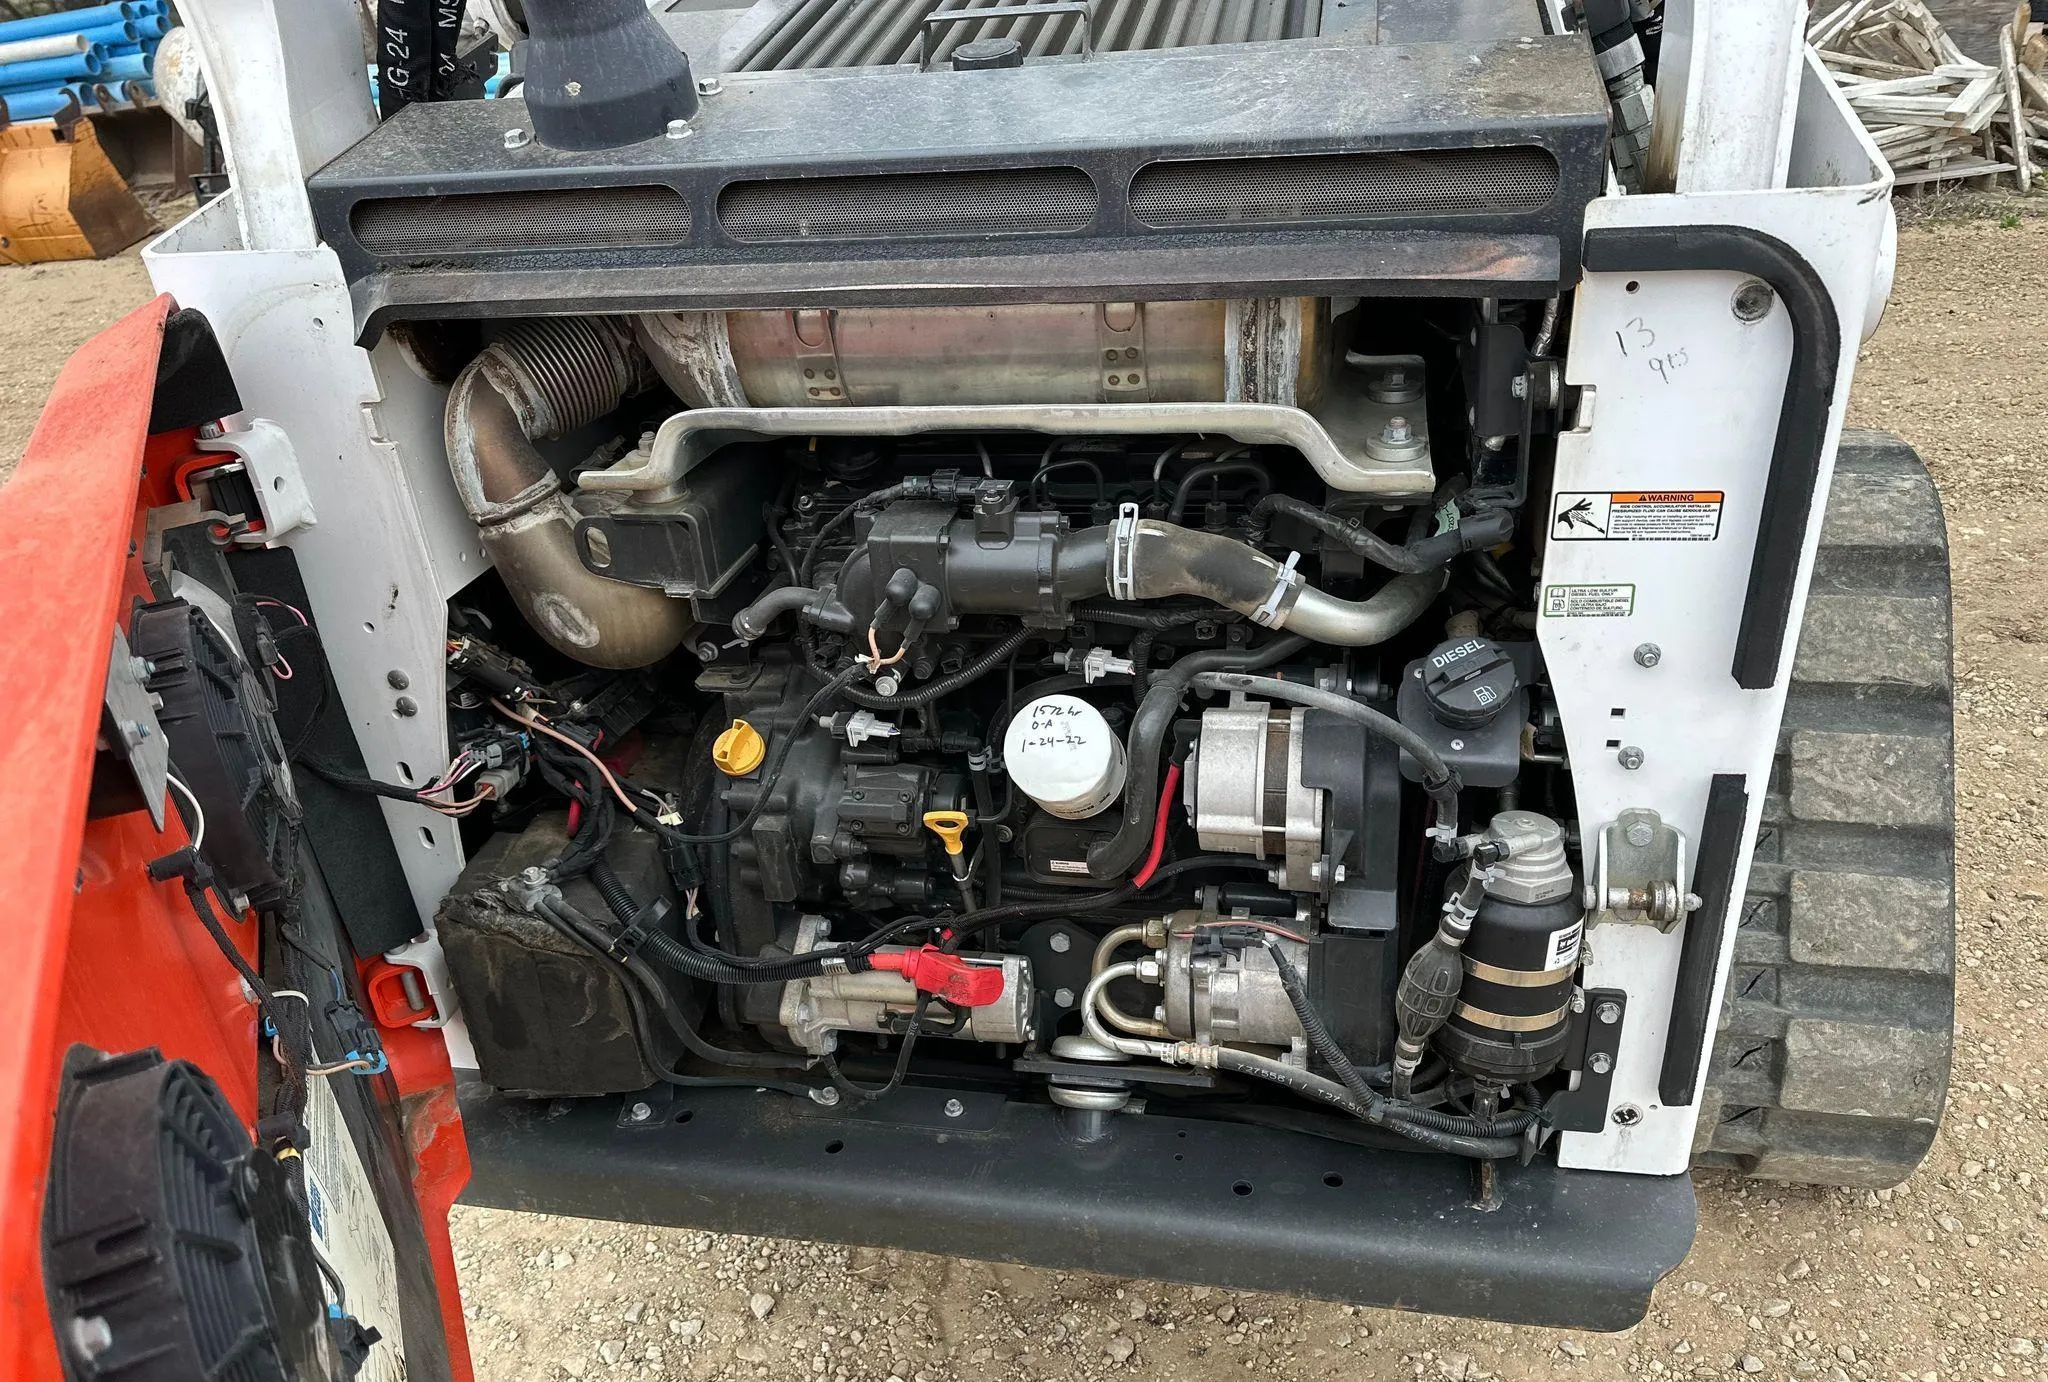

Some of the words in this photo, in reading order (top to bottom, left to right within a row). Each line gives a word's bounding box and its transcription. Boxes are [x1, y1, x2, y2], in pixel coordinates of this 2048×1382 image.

[1615, 317, 1656, 357] 13
[1647, 494, 1695, 502] WARNING
[1432, 640, 1486, 668] DIESEL
[1021, 736, 1087, 753] 1-24-22
